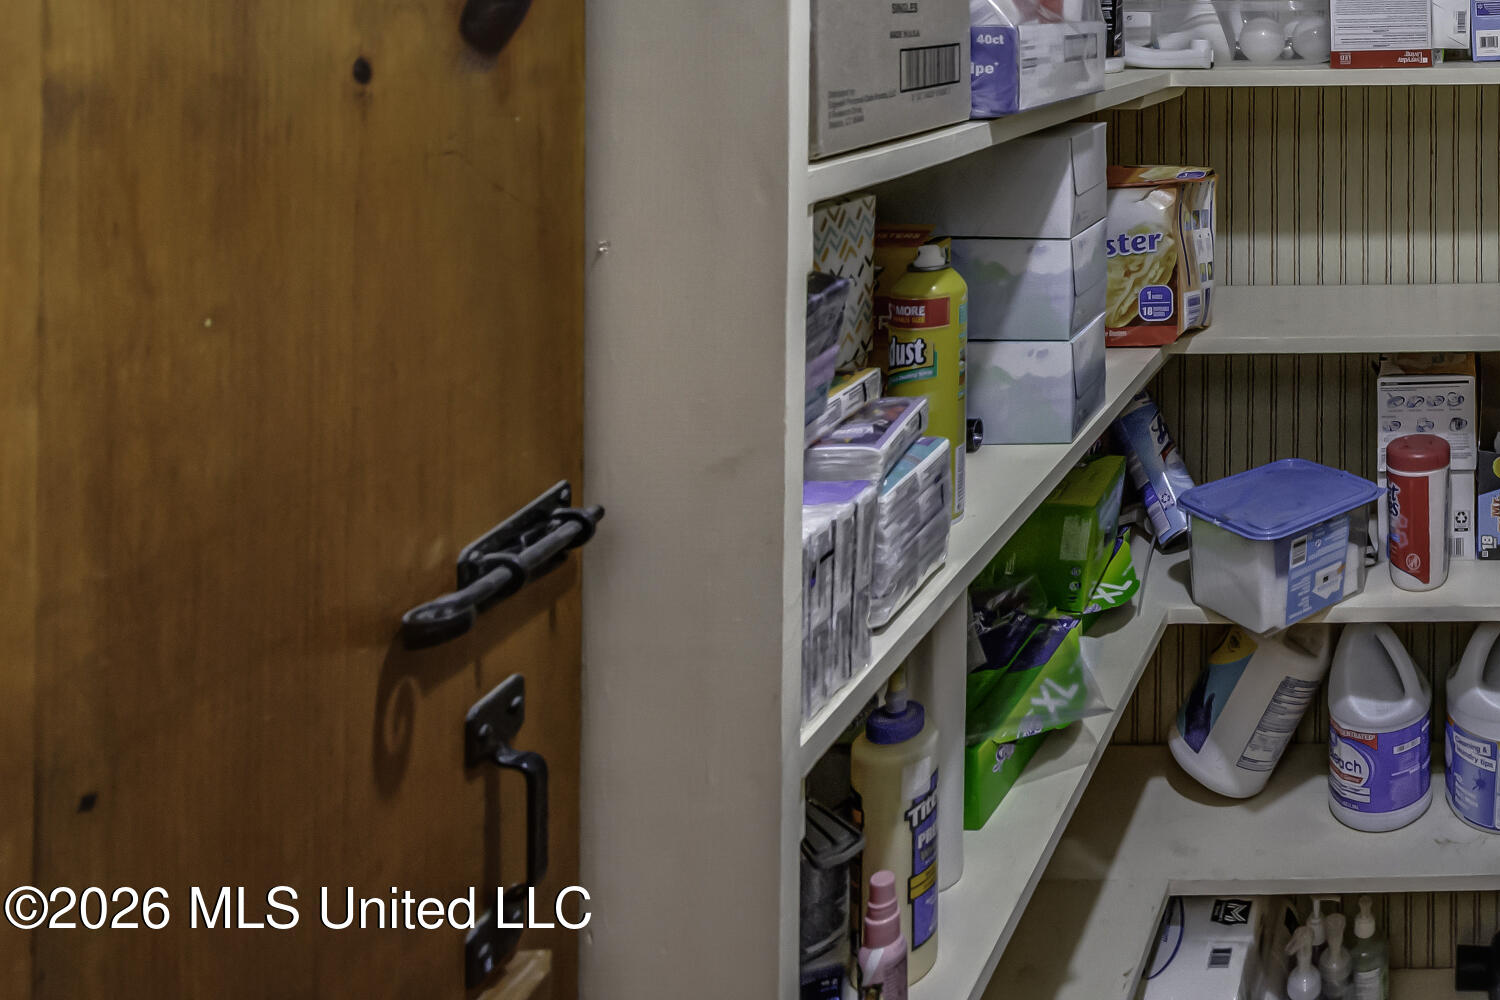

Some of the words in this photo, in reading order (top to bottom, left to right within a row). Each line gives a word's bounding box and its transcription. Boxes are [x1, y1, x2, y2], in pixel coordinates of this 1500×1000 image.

[976, 33, 1004, 45] 40ct
[1397, 56, 1423, 64] Everyday
[1106, 233, 1163, 256] ster
[896, 305, 926, 317] MORE
[1142, 306, 1153, 316] 18
[1481, 535, 1493, 549] 18
[1093, 580, 1132, 604] XL
[1031, 677, 1079, 714] XL
[1454, 734, 1481, 754] Cleaning
[1480, 758, 1494, 770] tips
